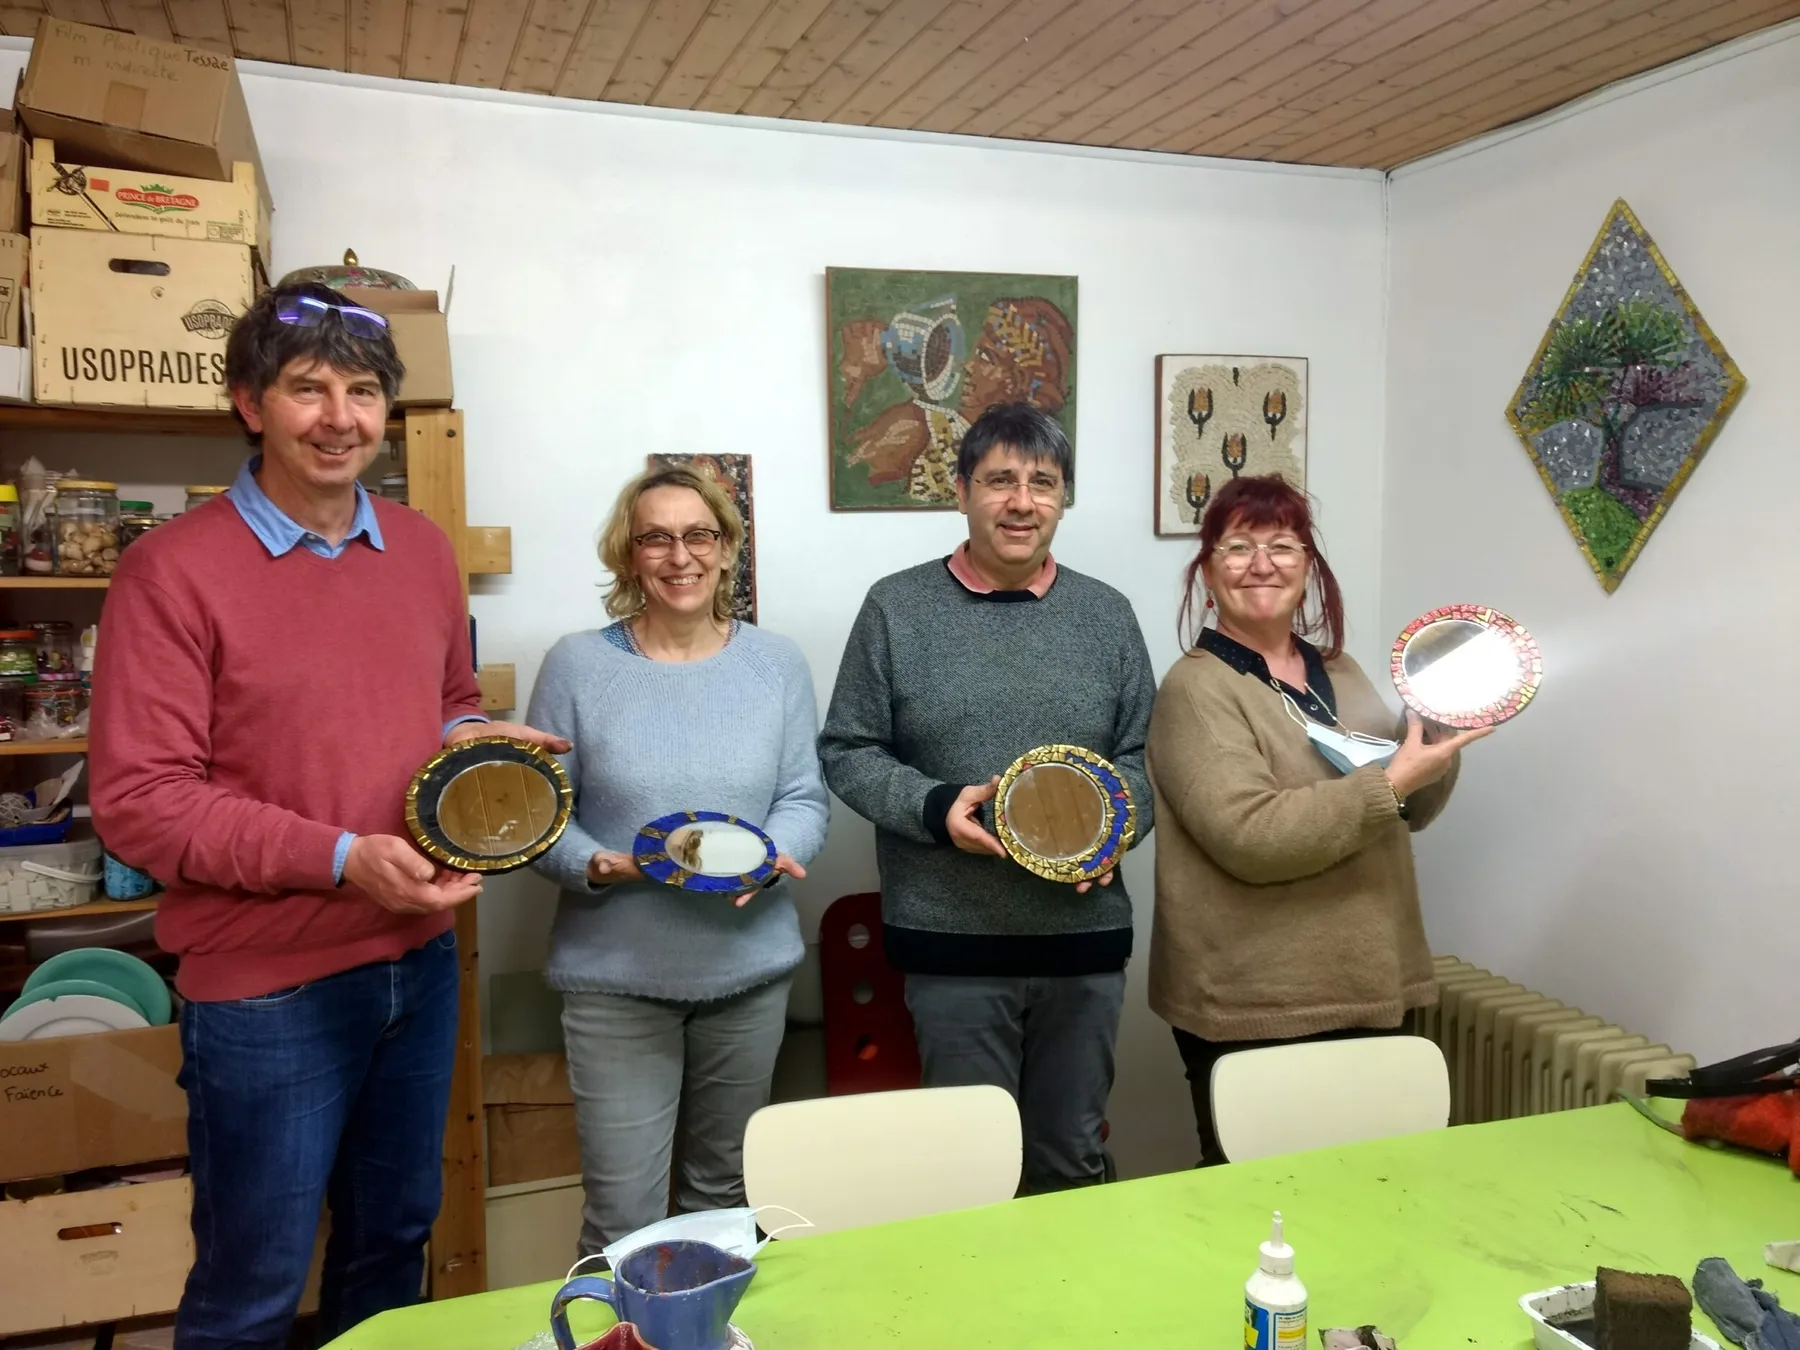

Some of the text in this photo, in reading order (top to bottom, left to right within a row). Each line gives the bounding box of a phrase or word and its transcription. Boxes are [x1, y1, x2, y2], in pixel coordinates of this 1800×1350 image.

[55, 24, 87, 43] Film
[117, 191, 146, 202] PRINCE
[155, 195, 198, 208] BRETAGNE
[61, 346, 225, 385] USOPRADES
[0, 1062, 50, 1079] ocaux
